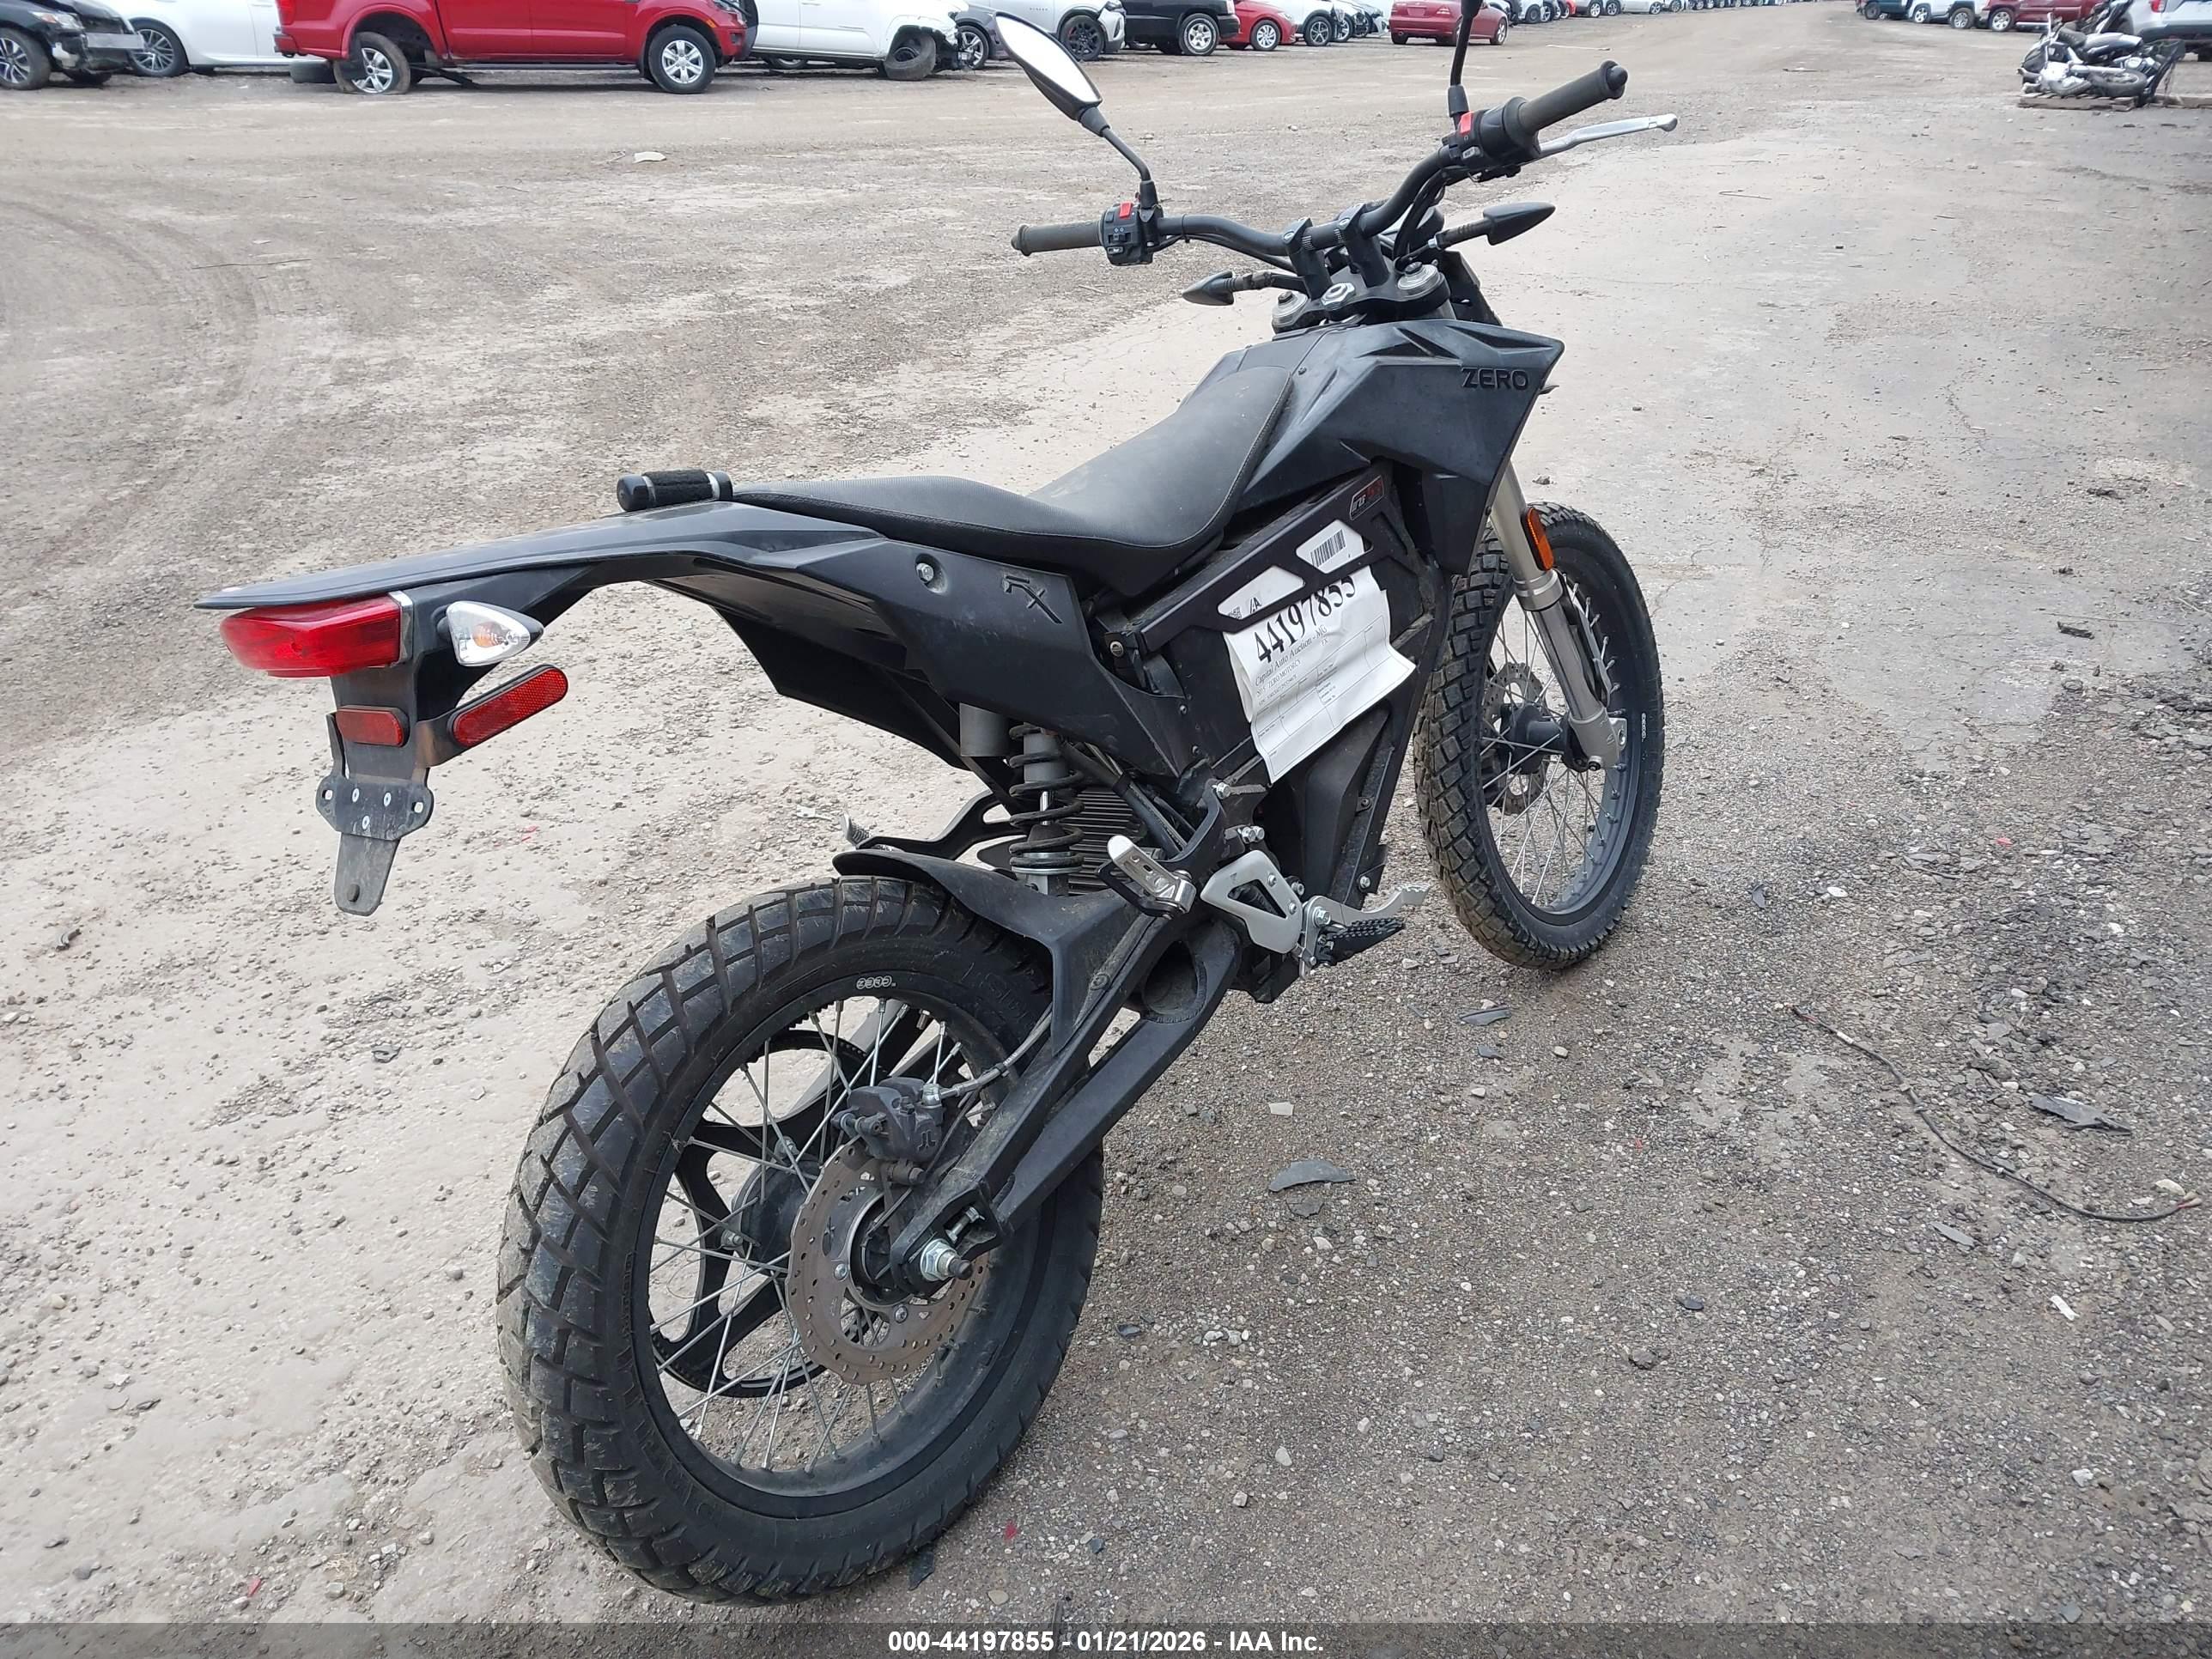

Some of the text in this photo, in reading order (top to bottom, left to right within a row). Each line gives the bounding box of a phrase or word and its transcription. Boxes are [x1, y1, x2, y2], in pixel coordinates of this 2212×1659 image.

[1461, 367, 1529, 391] ZERO
[1254, 575, 1356, 664] 44197855
[1255, 665, 1273, 687] Capital
[1274, 654, 1289, 672] Auto
[1290, 638, 1312, 659] Auction
[1315, 623, 1328, 639] MG
